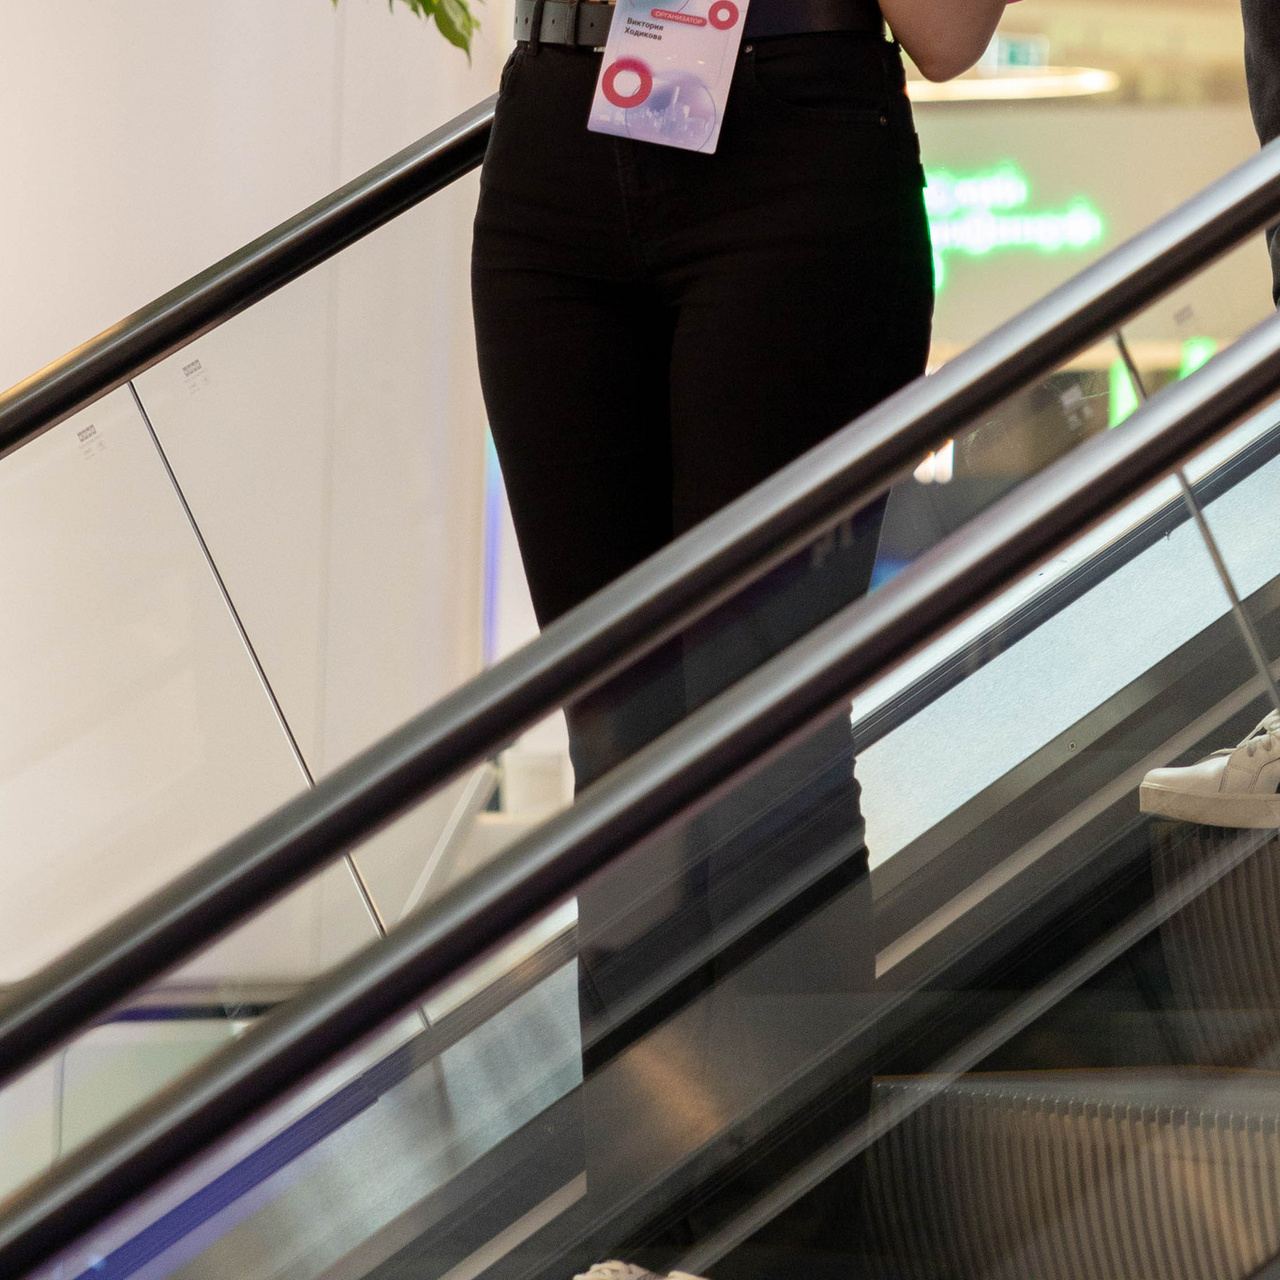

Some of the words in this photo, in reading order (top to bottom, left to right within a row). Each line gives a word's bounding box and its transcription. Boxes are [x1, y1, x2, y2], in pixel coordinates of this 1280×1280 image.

[627, 17, 664, 31] Виктория
[655, 10, 703, 24] ОРГАНИЗАТОР
[624, 26, 662, 41] Ходикова
